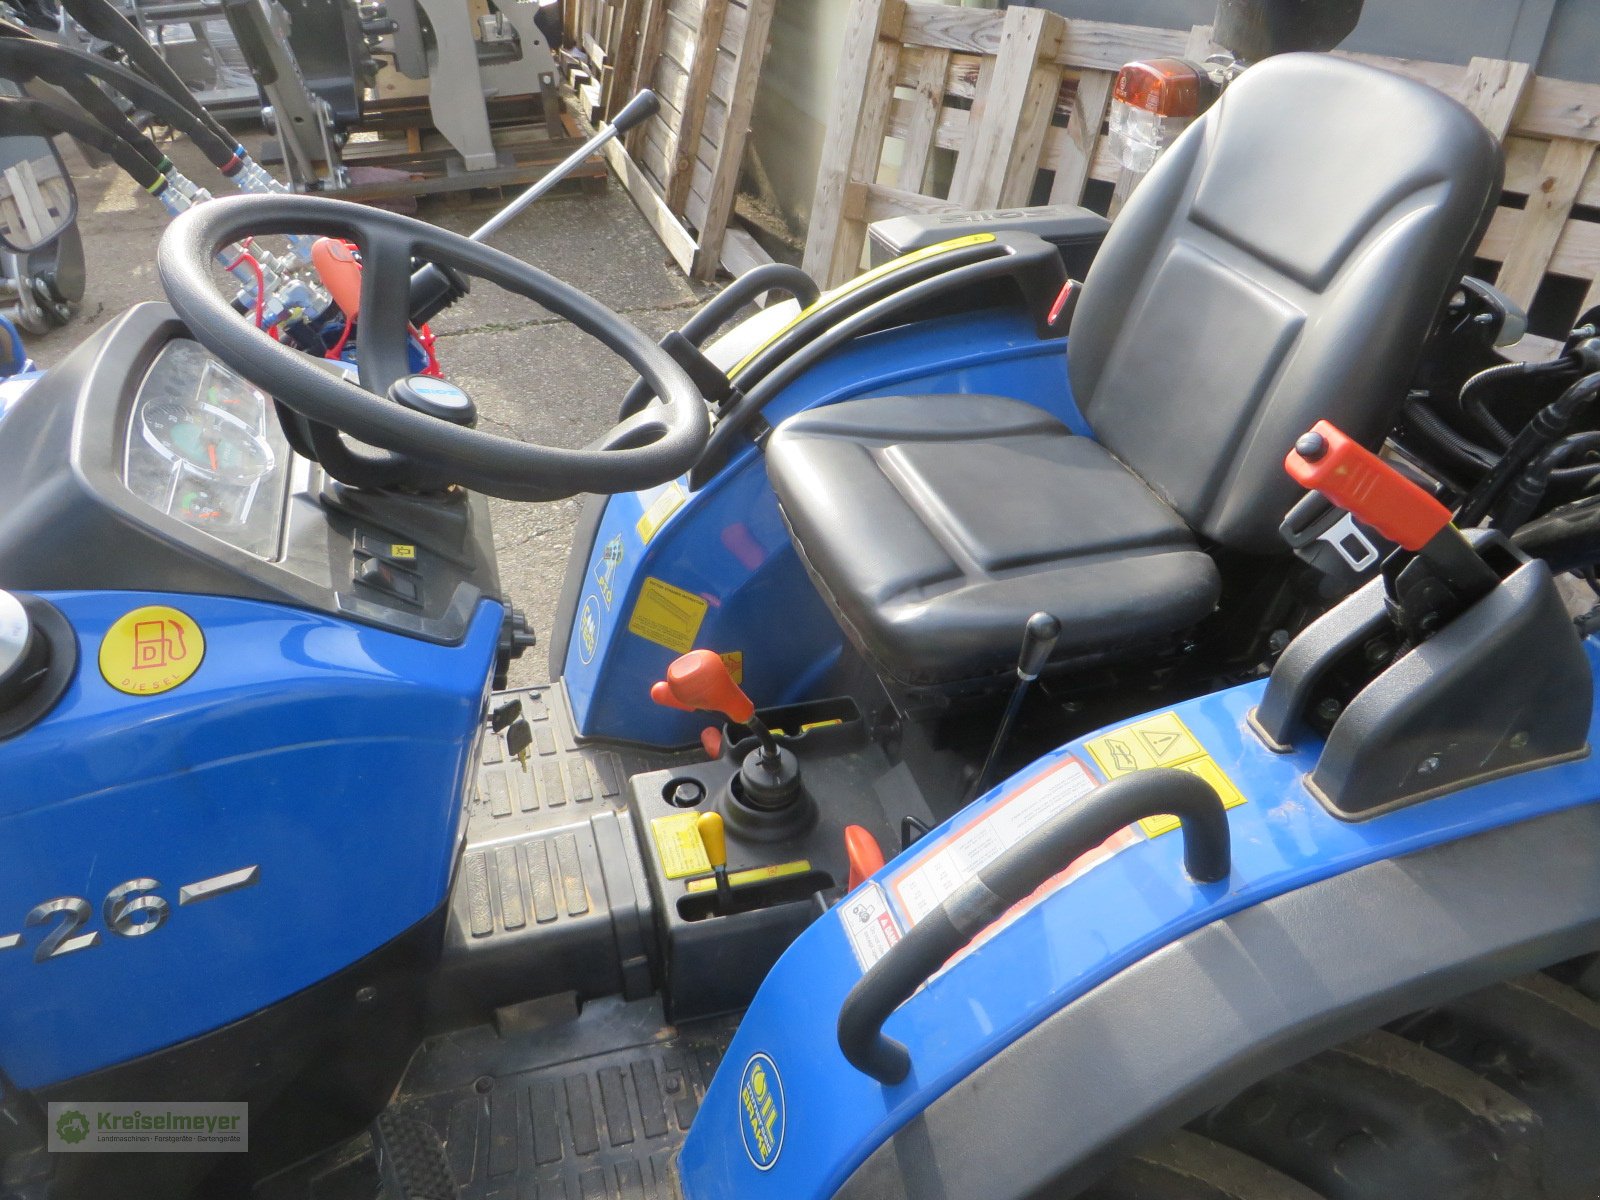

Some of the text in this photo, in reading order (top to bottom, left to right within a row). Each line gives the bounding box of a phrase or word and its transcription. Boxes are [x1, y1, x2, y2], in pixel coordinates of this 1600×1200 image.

[121, 673, 181, 692] DIESEL
[742, 1087, 769, 1162] BRAKE
[751, 1062, 777, 1143] OIL
